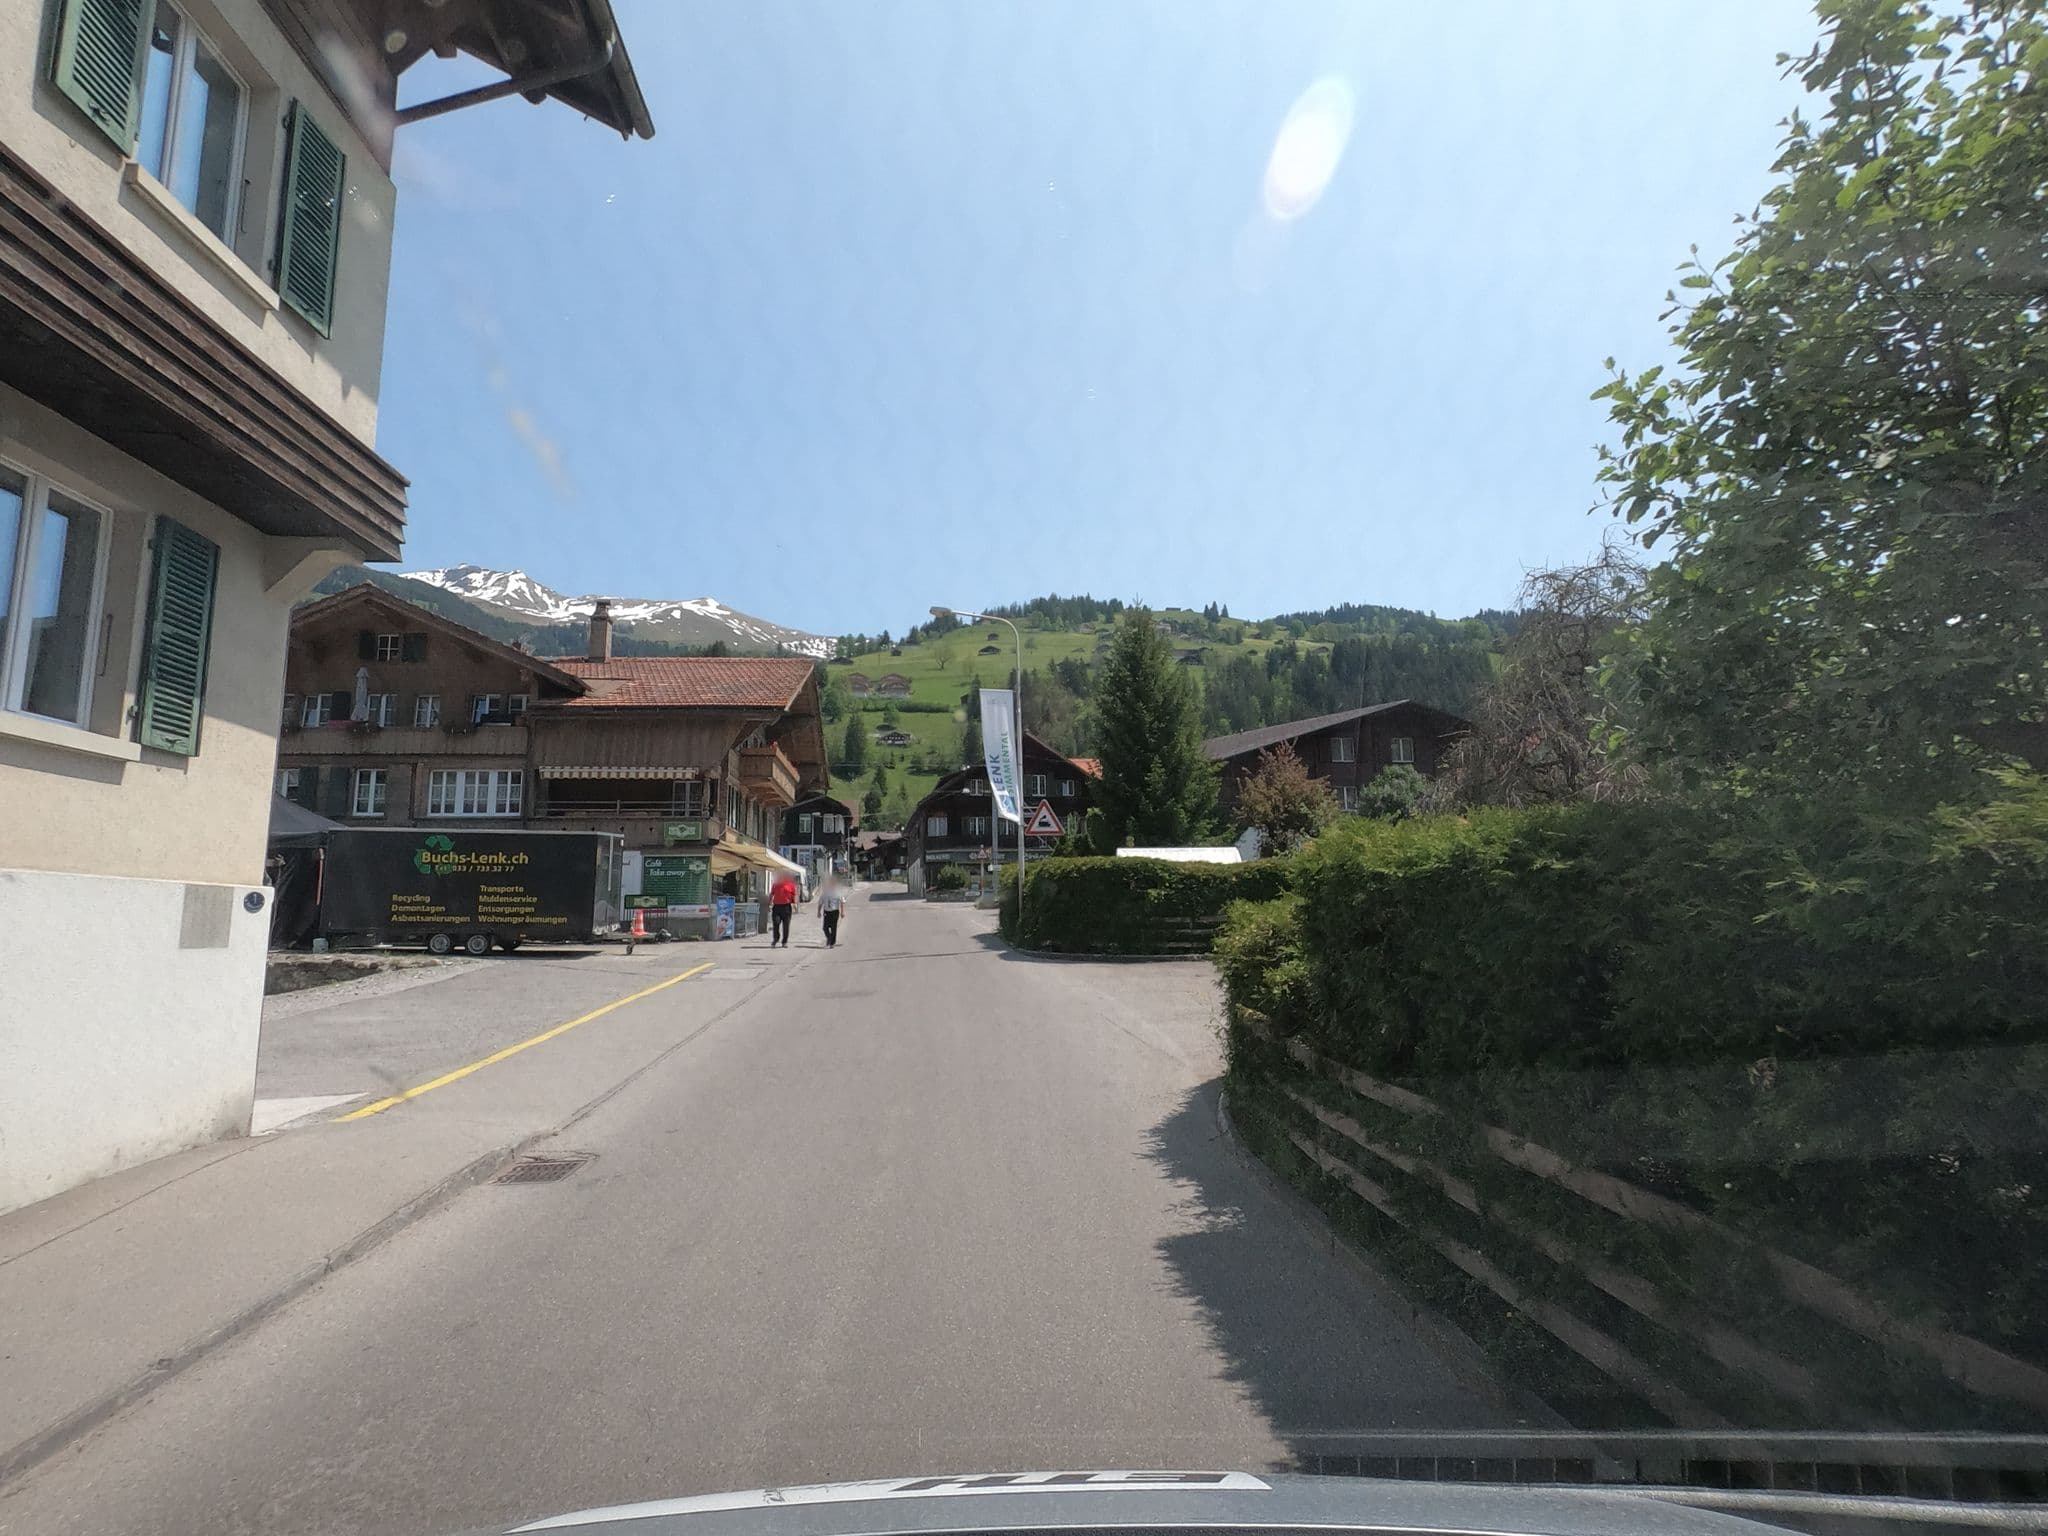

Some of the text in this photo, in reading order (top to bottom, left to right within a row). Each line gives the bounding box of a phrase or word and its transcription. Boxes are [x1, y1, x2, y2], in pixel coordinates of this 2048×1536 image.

[1000, 731, 1014, 795] SIMMENTAL
[989, 753, 1004, 793] LENK
[421, 851, 529, 865] Buchs-Lenk.ch
[480, 884, 524, 894] Transporte
[392, 894, 431, 903] Recycling
[479, 894, 538, 903] Muldenservice
[391, 904, 445, 913] Demontagen
[478, 905, 535, 914] Entsorgungen
[391, 914, 471, 924] Asbestsanierungen
[478, 914, 569, 925] Wohnungsräumungen
